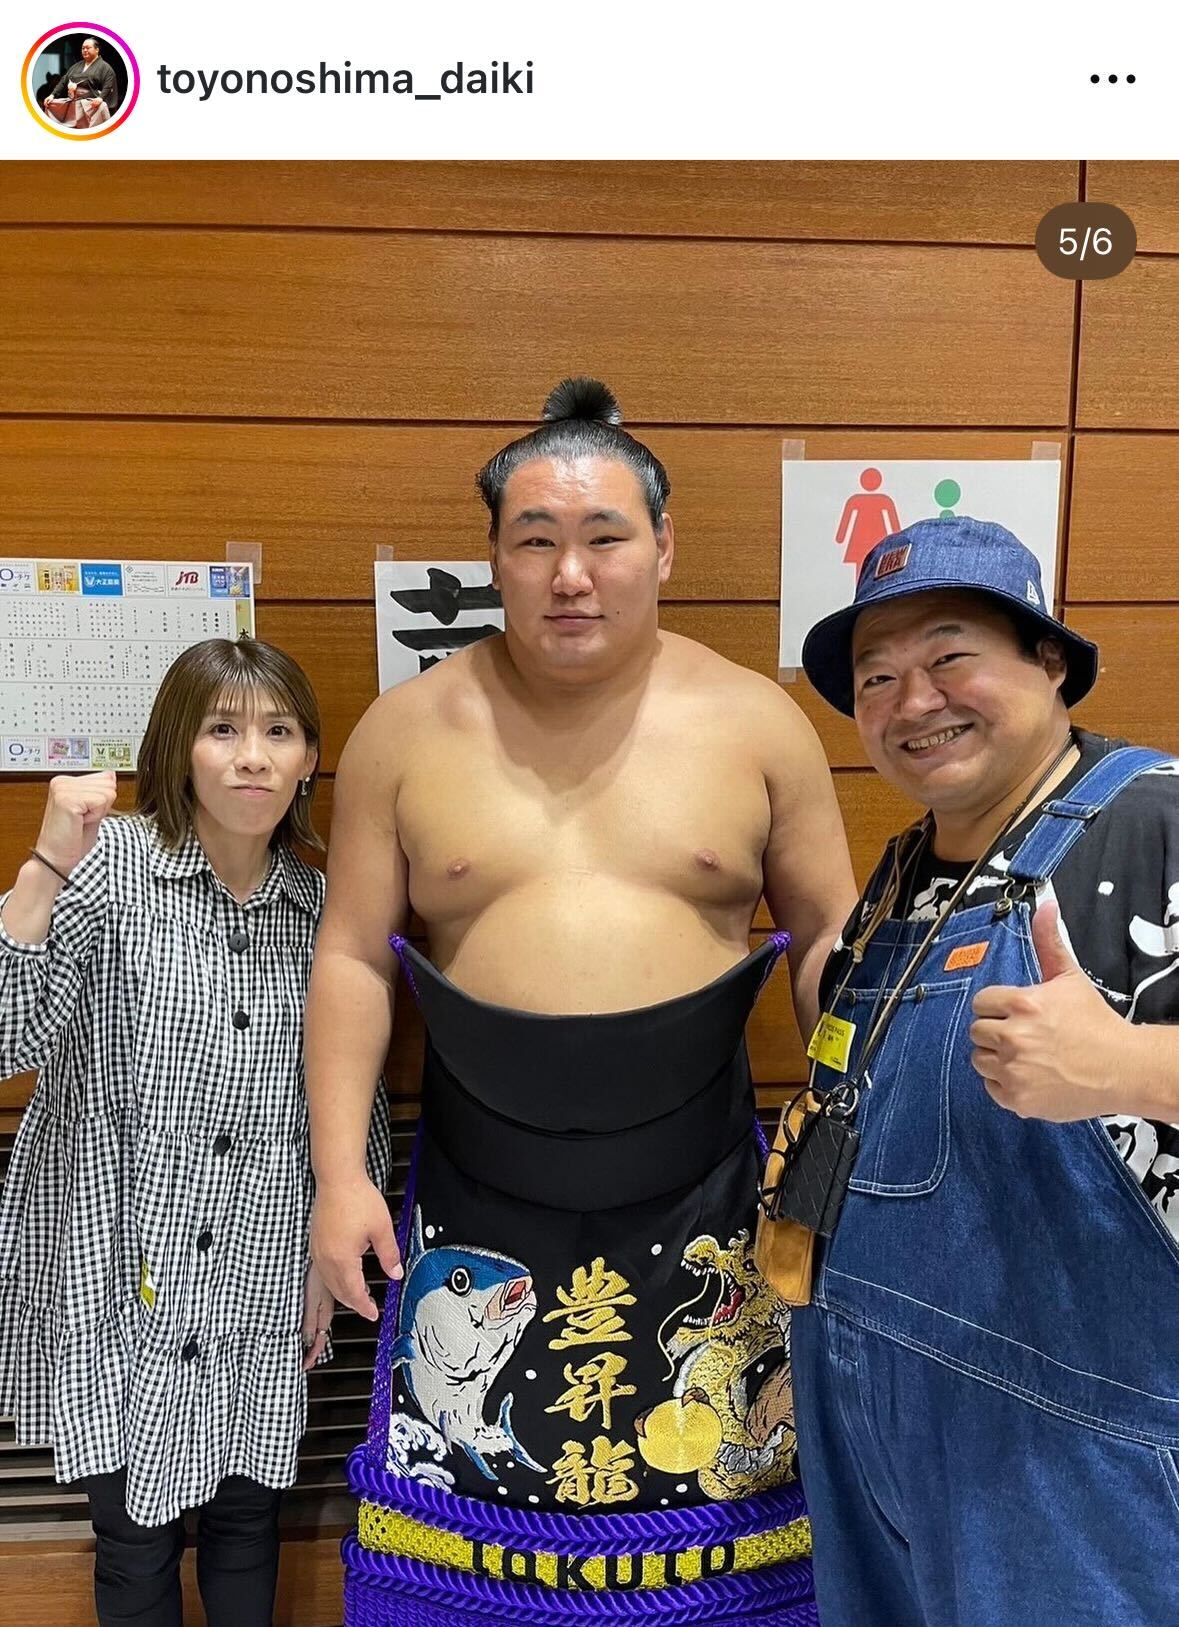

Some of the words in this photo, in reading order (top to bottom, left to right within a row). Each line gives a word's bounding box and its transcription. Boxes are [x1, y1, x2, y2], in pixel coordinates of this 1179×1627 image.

[175, 571, 199, 586] JTB
[542, 1256, 640, 1508] 豊昇龍
